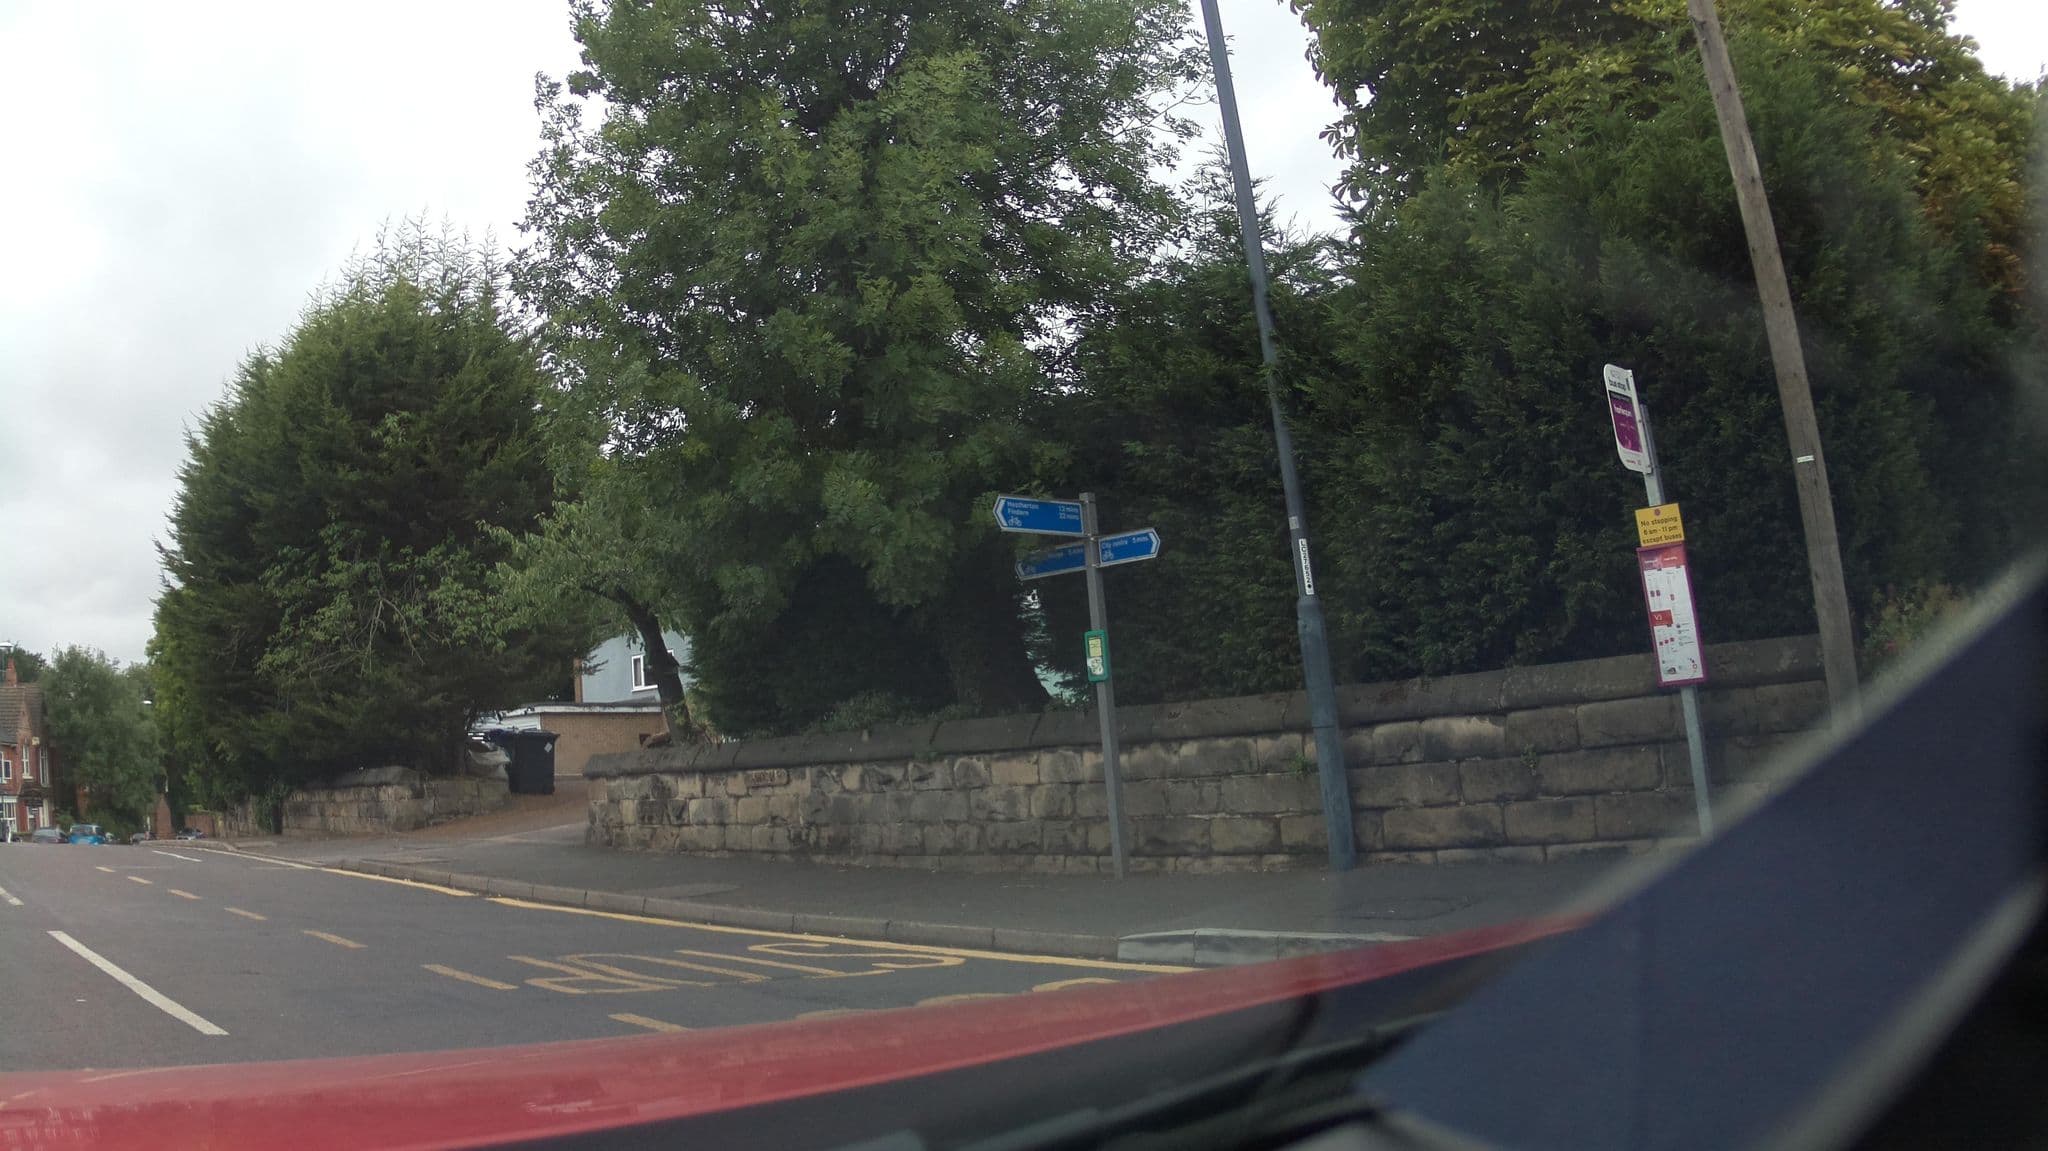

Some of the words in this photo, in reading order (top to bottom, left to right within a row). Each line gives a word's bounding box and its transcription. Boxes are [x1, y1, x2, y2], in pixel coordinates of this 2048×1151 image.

[1640, 520, 1650, 528] No
[1651, 516, 1678, 526] stopping
[1642, 535, 1663, 544] except
[507, 942, 966, 994] BUS
